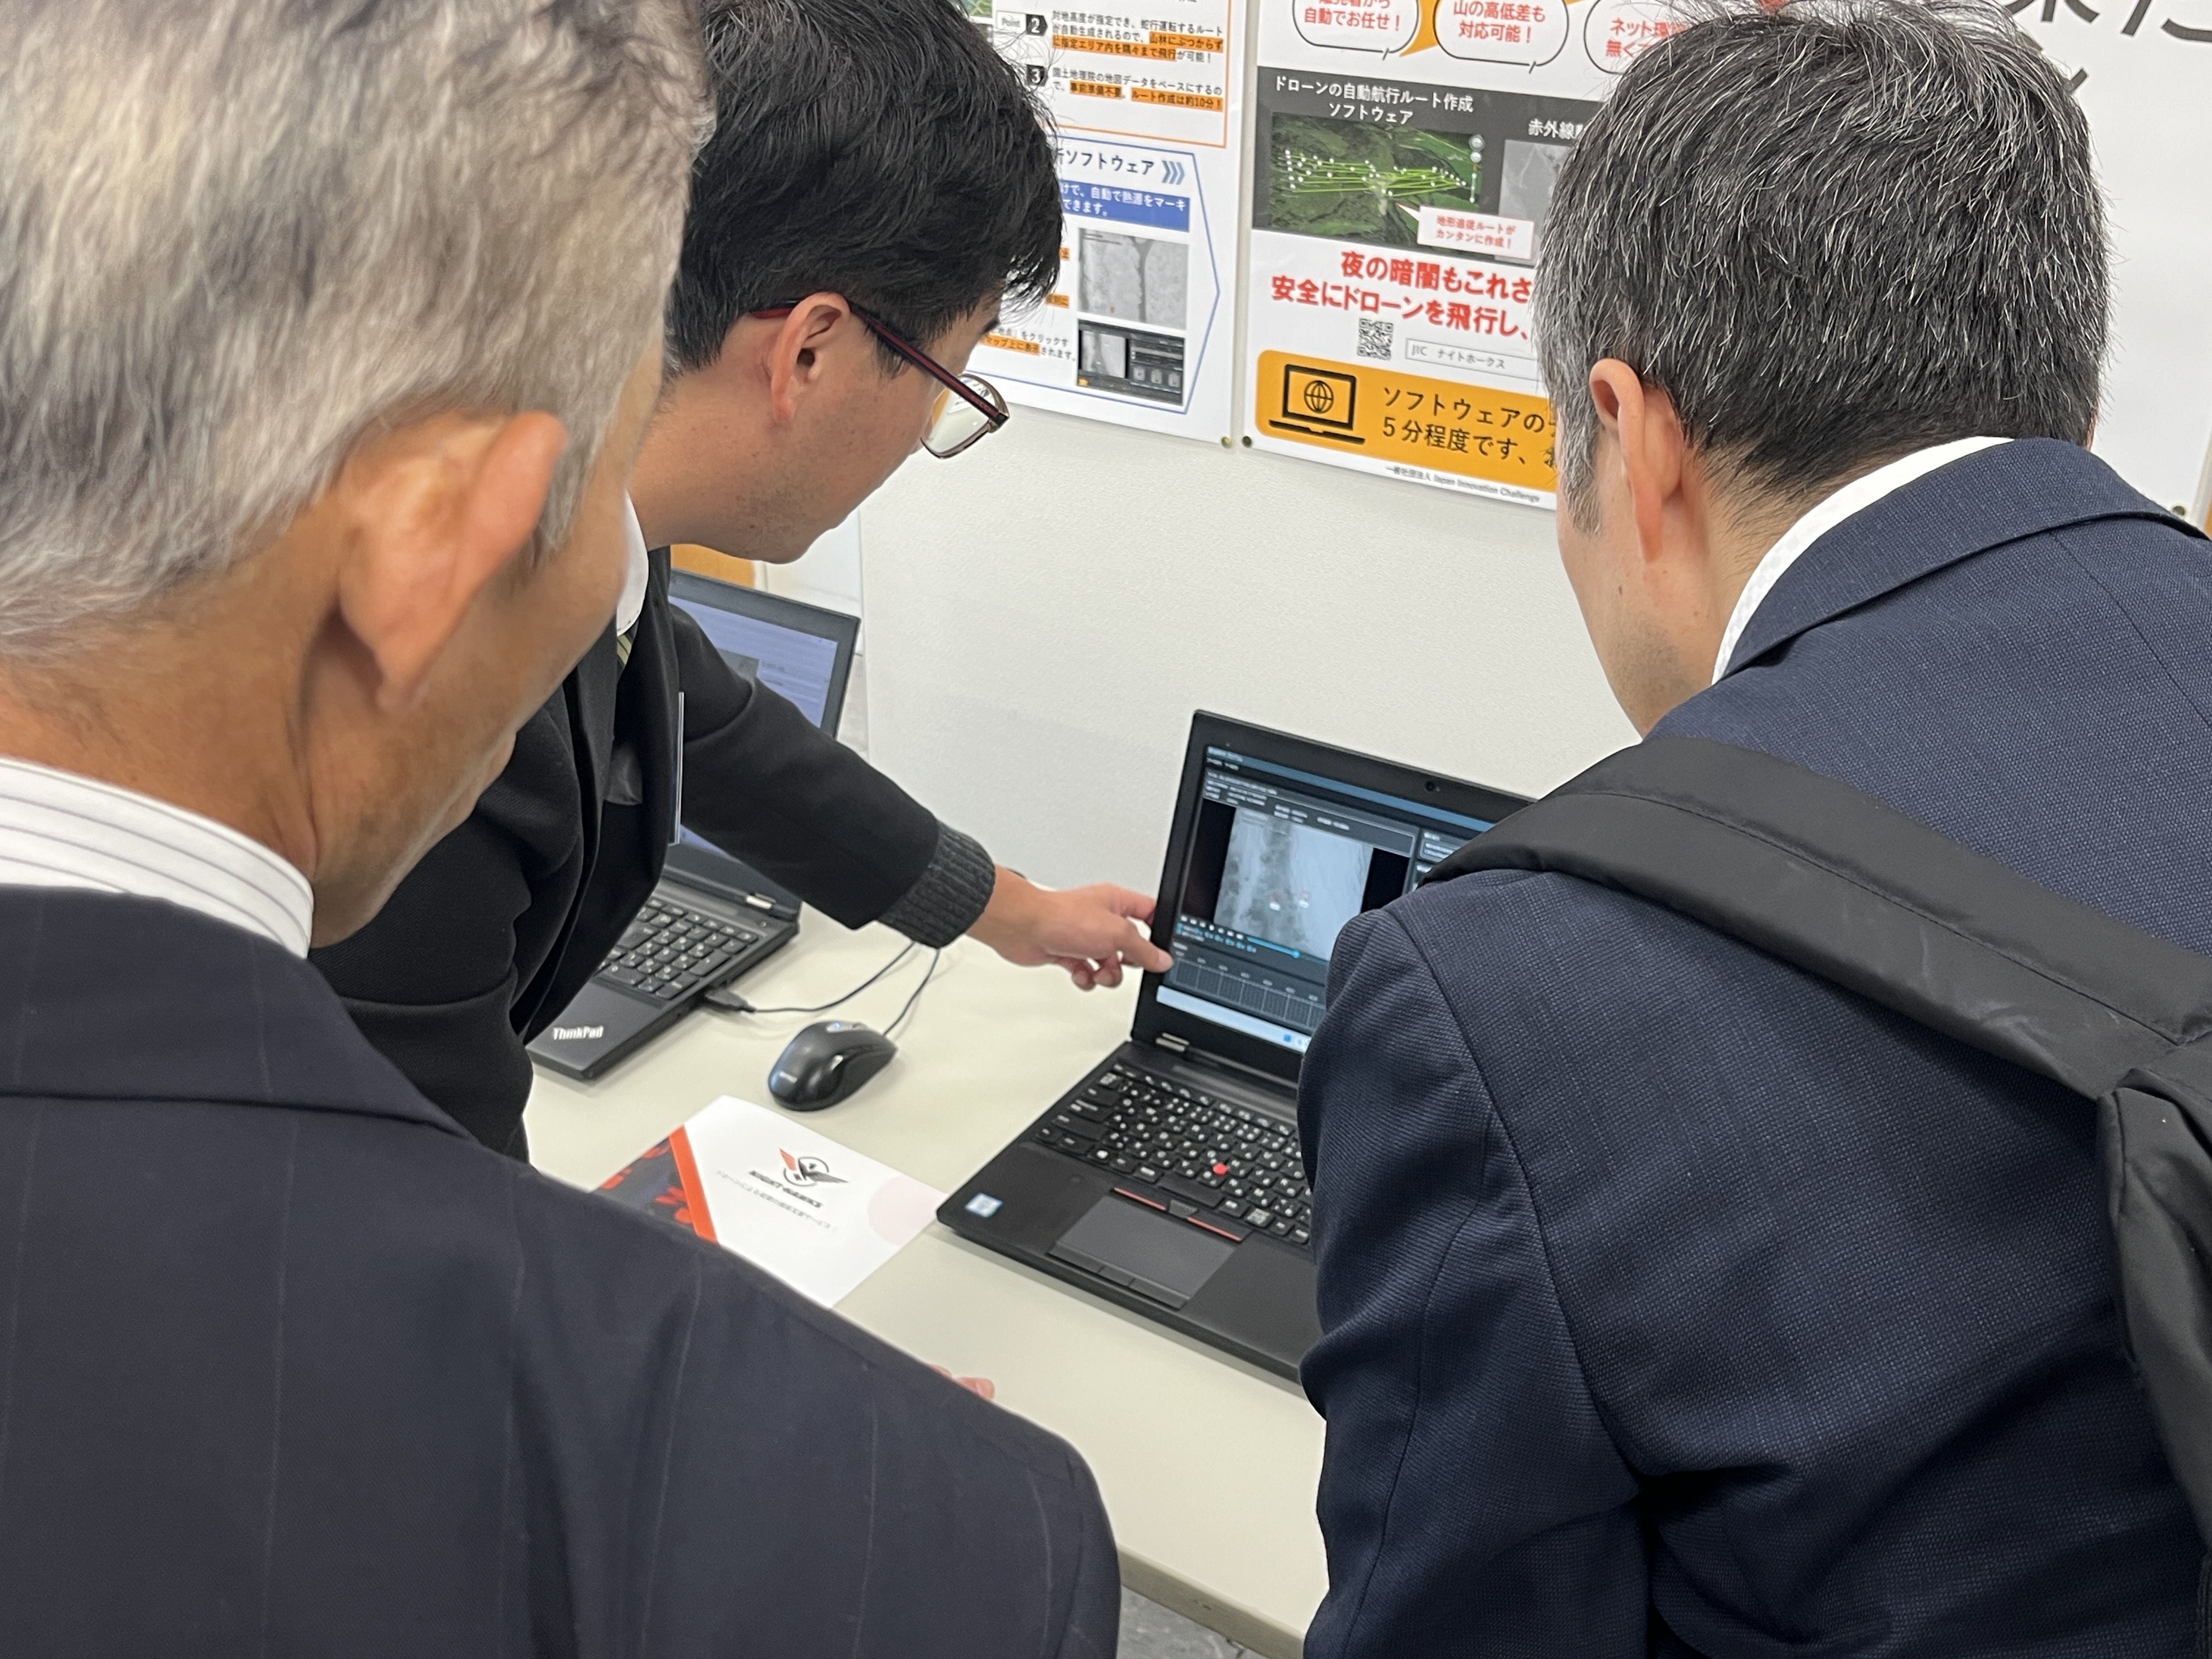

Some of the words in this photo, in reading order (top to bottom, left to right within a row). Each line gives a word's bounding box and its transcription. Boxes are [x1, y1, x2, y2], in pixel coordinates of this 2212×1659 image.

[1304, 7, 1400, 31] 自動でお任せ！
[1454, 0, 1546, 22] 山の高低差も
[1031, 17, 1040, 33] 2
[1458, 20, 1531, 43] 対応可能！
[1031, 68, 1041, 83] 3
[1276, 76, 1474, 113] ドローンの自動航行ルート作成
[1329, 103, 1414, 125] ソフトウェア
[1271, 275, 1528, 341] 安全にドローンを飛行し、
[554, 1025, 603, 1040] ThinkPad
